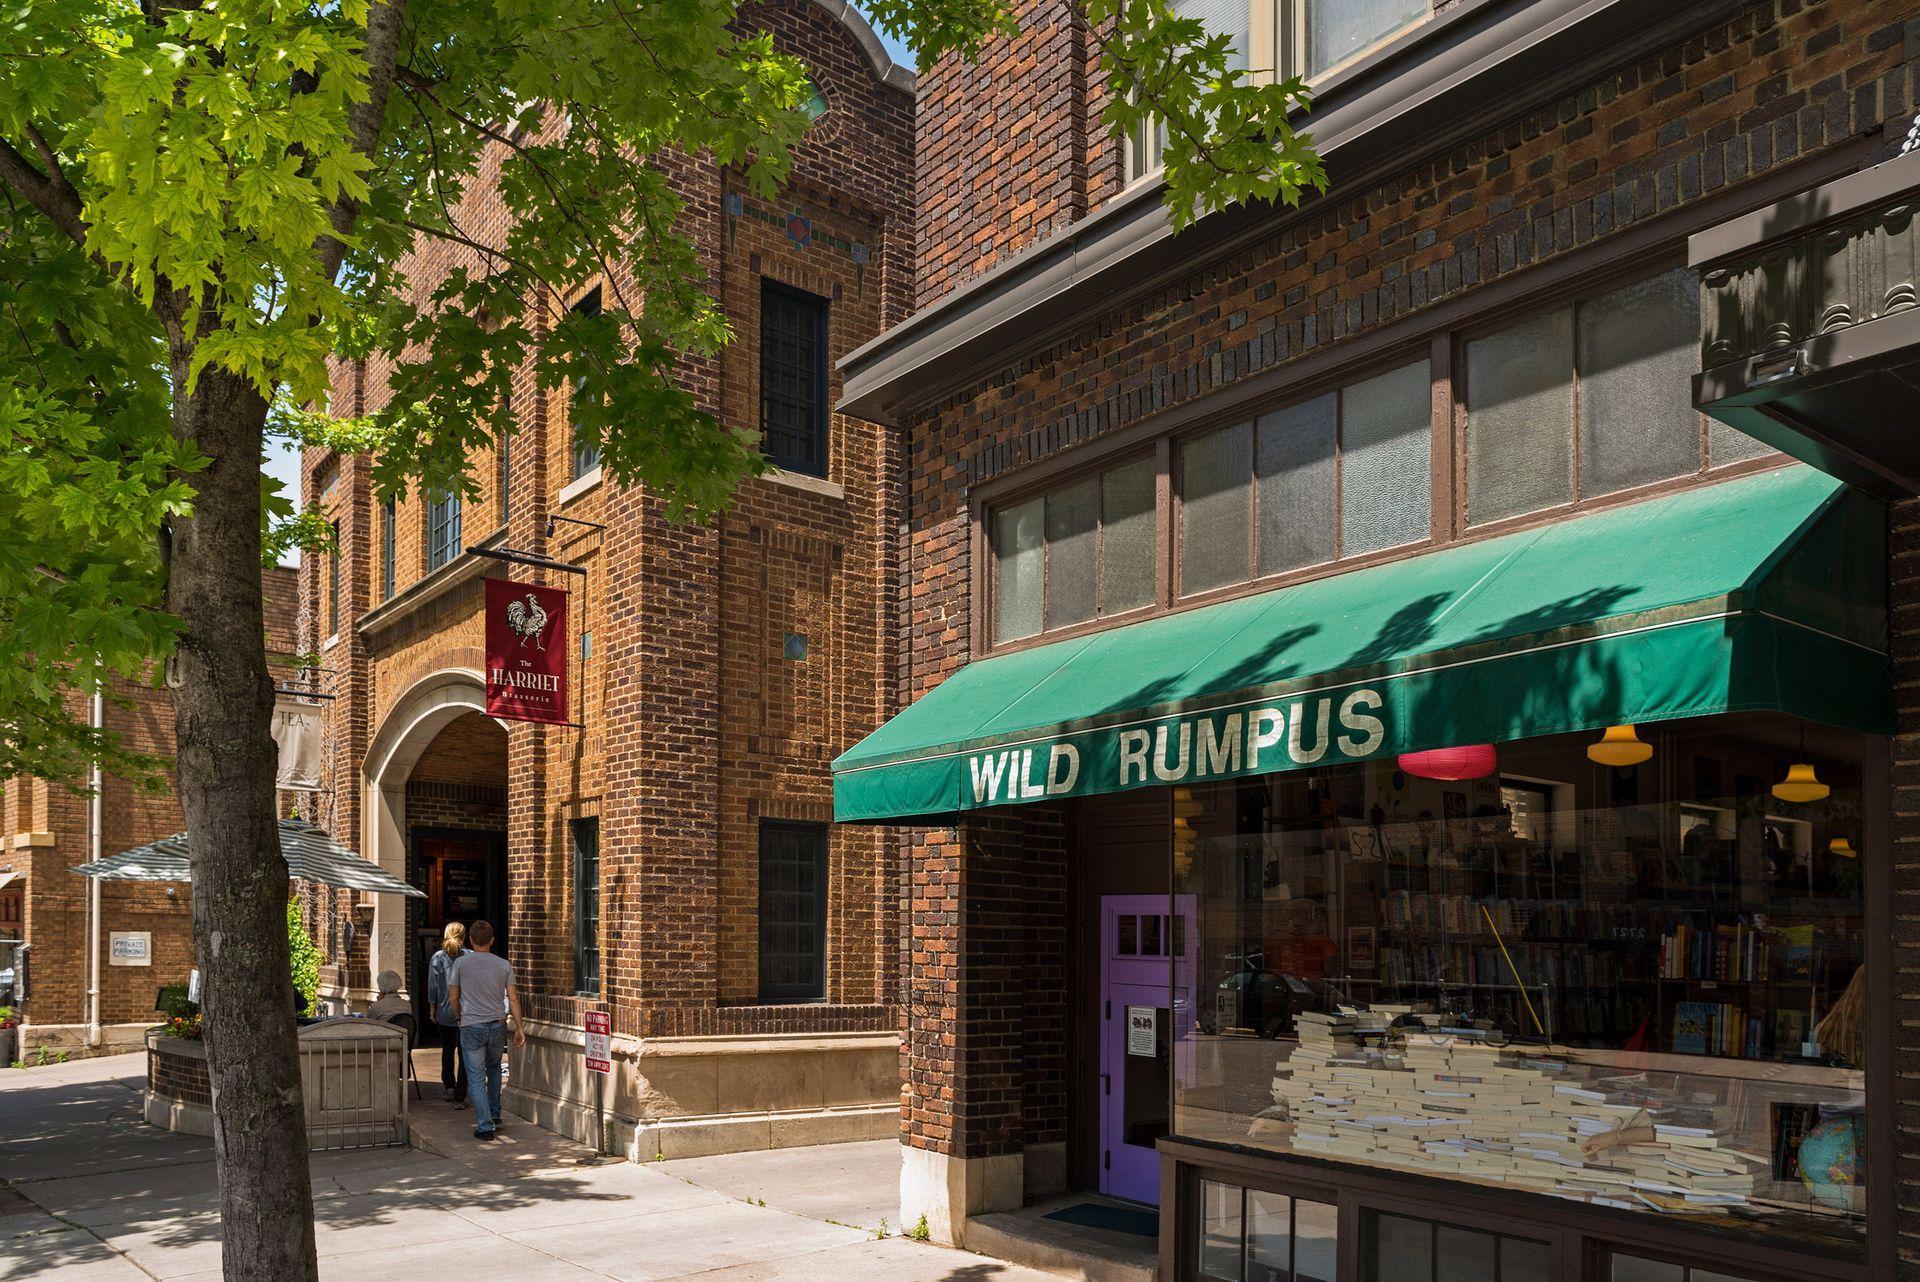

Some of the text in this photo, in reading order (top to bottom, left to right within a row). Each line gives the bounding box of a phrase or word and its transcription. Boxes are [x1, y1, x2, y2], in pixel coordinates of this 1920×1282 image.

[492, 668, 560, 692] HARRIET
[502, 691, 550, 703] Brasserie
[279, 710, 304, 727] TEA
[968, 690, 1385, 804] WILD RUMPUS
[586, 1013, 609, 1025] NO PARKING
